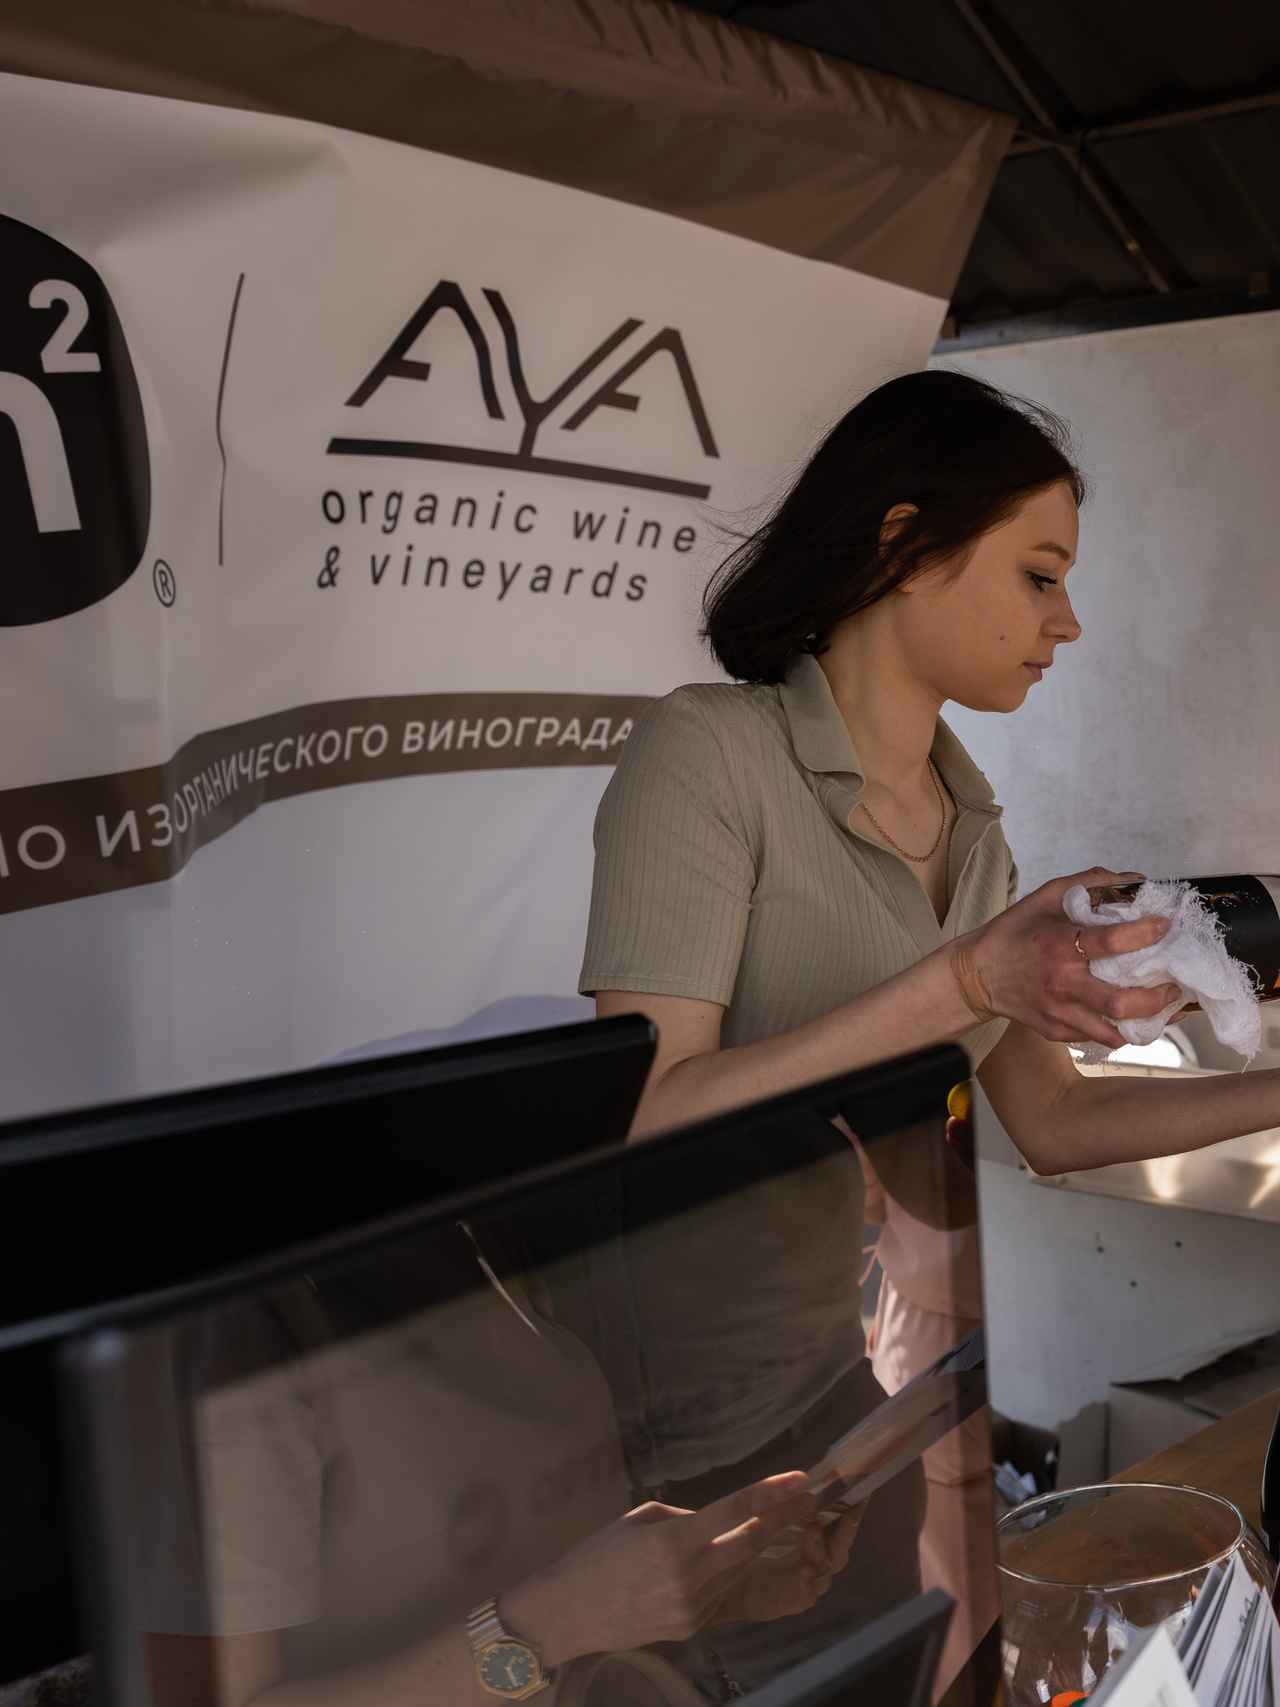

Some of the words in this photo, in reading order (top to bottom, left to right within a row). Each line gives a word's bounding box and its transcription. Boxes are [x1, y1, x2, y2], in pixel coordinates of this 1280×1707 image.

[344, 279, 721, 458] AYA
[321, 489, 538, 534] organic
[573, 507, 697, 553] wine
[317, 545, 341, 590] &
[370, 544, 648, 601] vineyards
[96, 803, 173, 858] ИЗ
[173, 723, 389, 833] ОРГАНИЧЕСКОГО
[402, 717, 634, 754] ВИНОГРАДА
